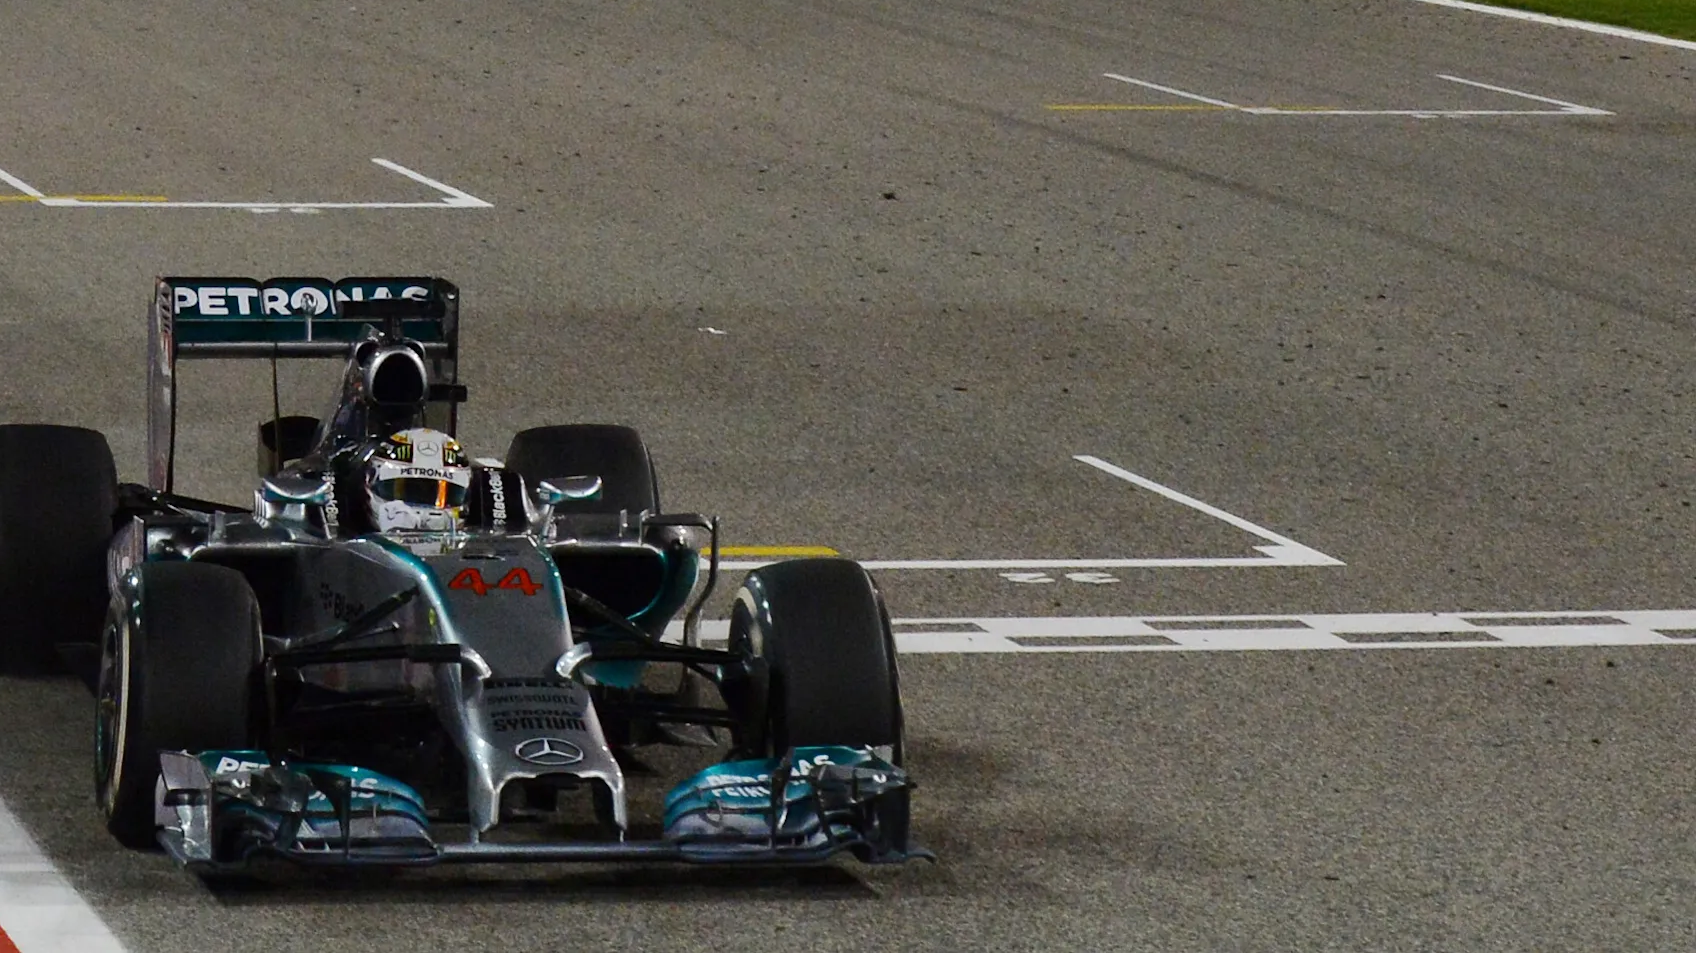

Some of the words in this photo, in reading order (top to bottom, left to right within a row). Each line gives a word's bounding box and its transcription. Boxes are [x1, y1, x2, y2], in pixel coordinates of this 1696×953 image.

[400, 467, 454, 480] PETRONAS
[448, 567, 544, 596] 44
[493, 717, 587, 732] SYNTIUM
